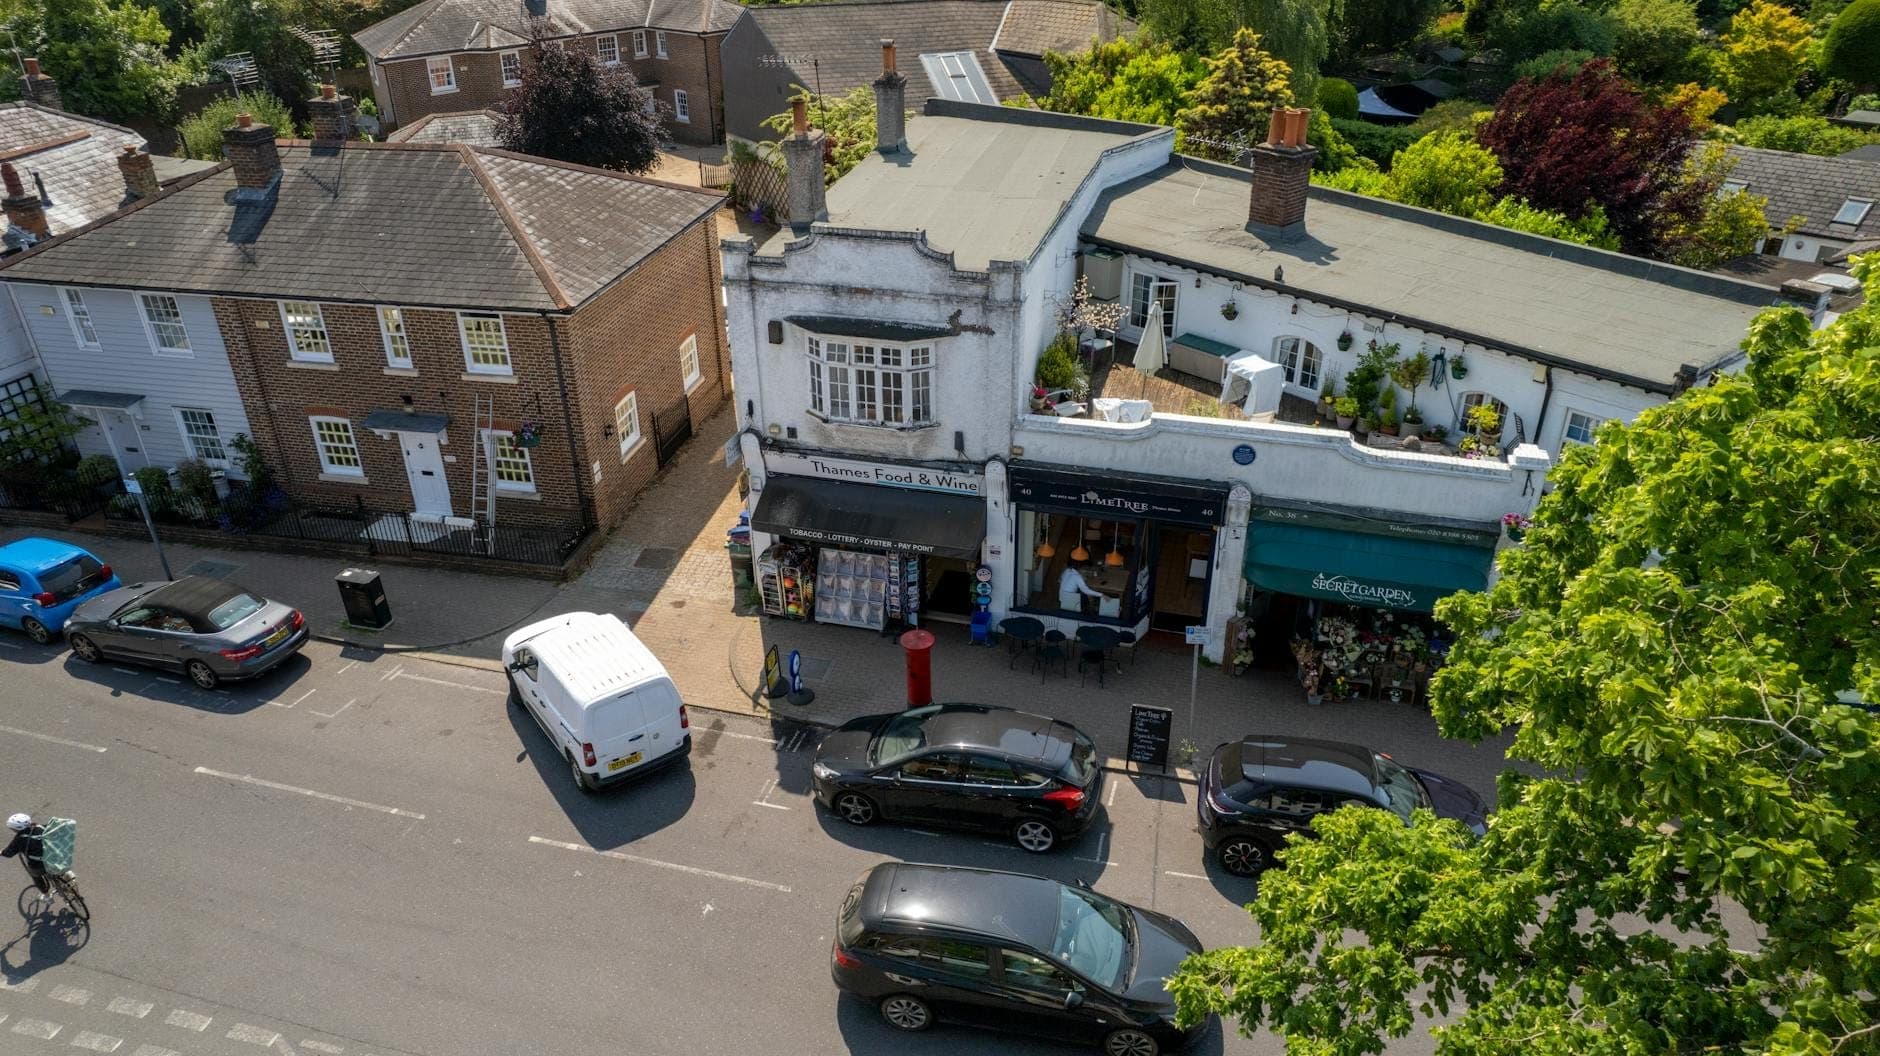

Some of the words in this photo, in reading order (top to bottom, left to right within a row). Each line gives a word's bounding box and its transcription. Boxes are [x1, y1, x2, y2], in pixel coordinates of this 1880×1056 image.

[811, 460, 870, 479] Thames
[875, 468, 912, 484] Food
[919, 473, 931, 486] &
[936, 474, 977, 491] Wine
[1021, 488, 1032, 496] 40
[789, 528, 823, 539] TOBACCO
[828, 533, 859, 544] LOTTERY
[864, 538, 892, 548] OYSTER
[898, 542, 912, 550] PAY
[912, 544, 934, 553] POINT
